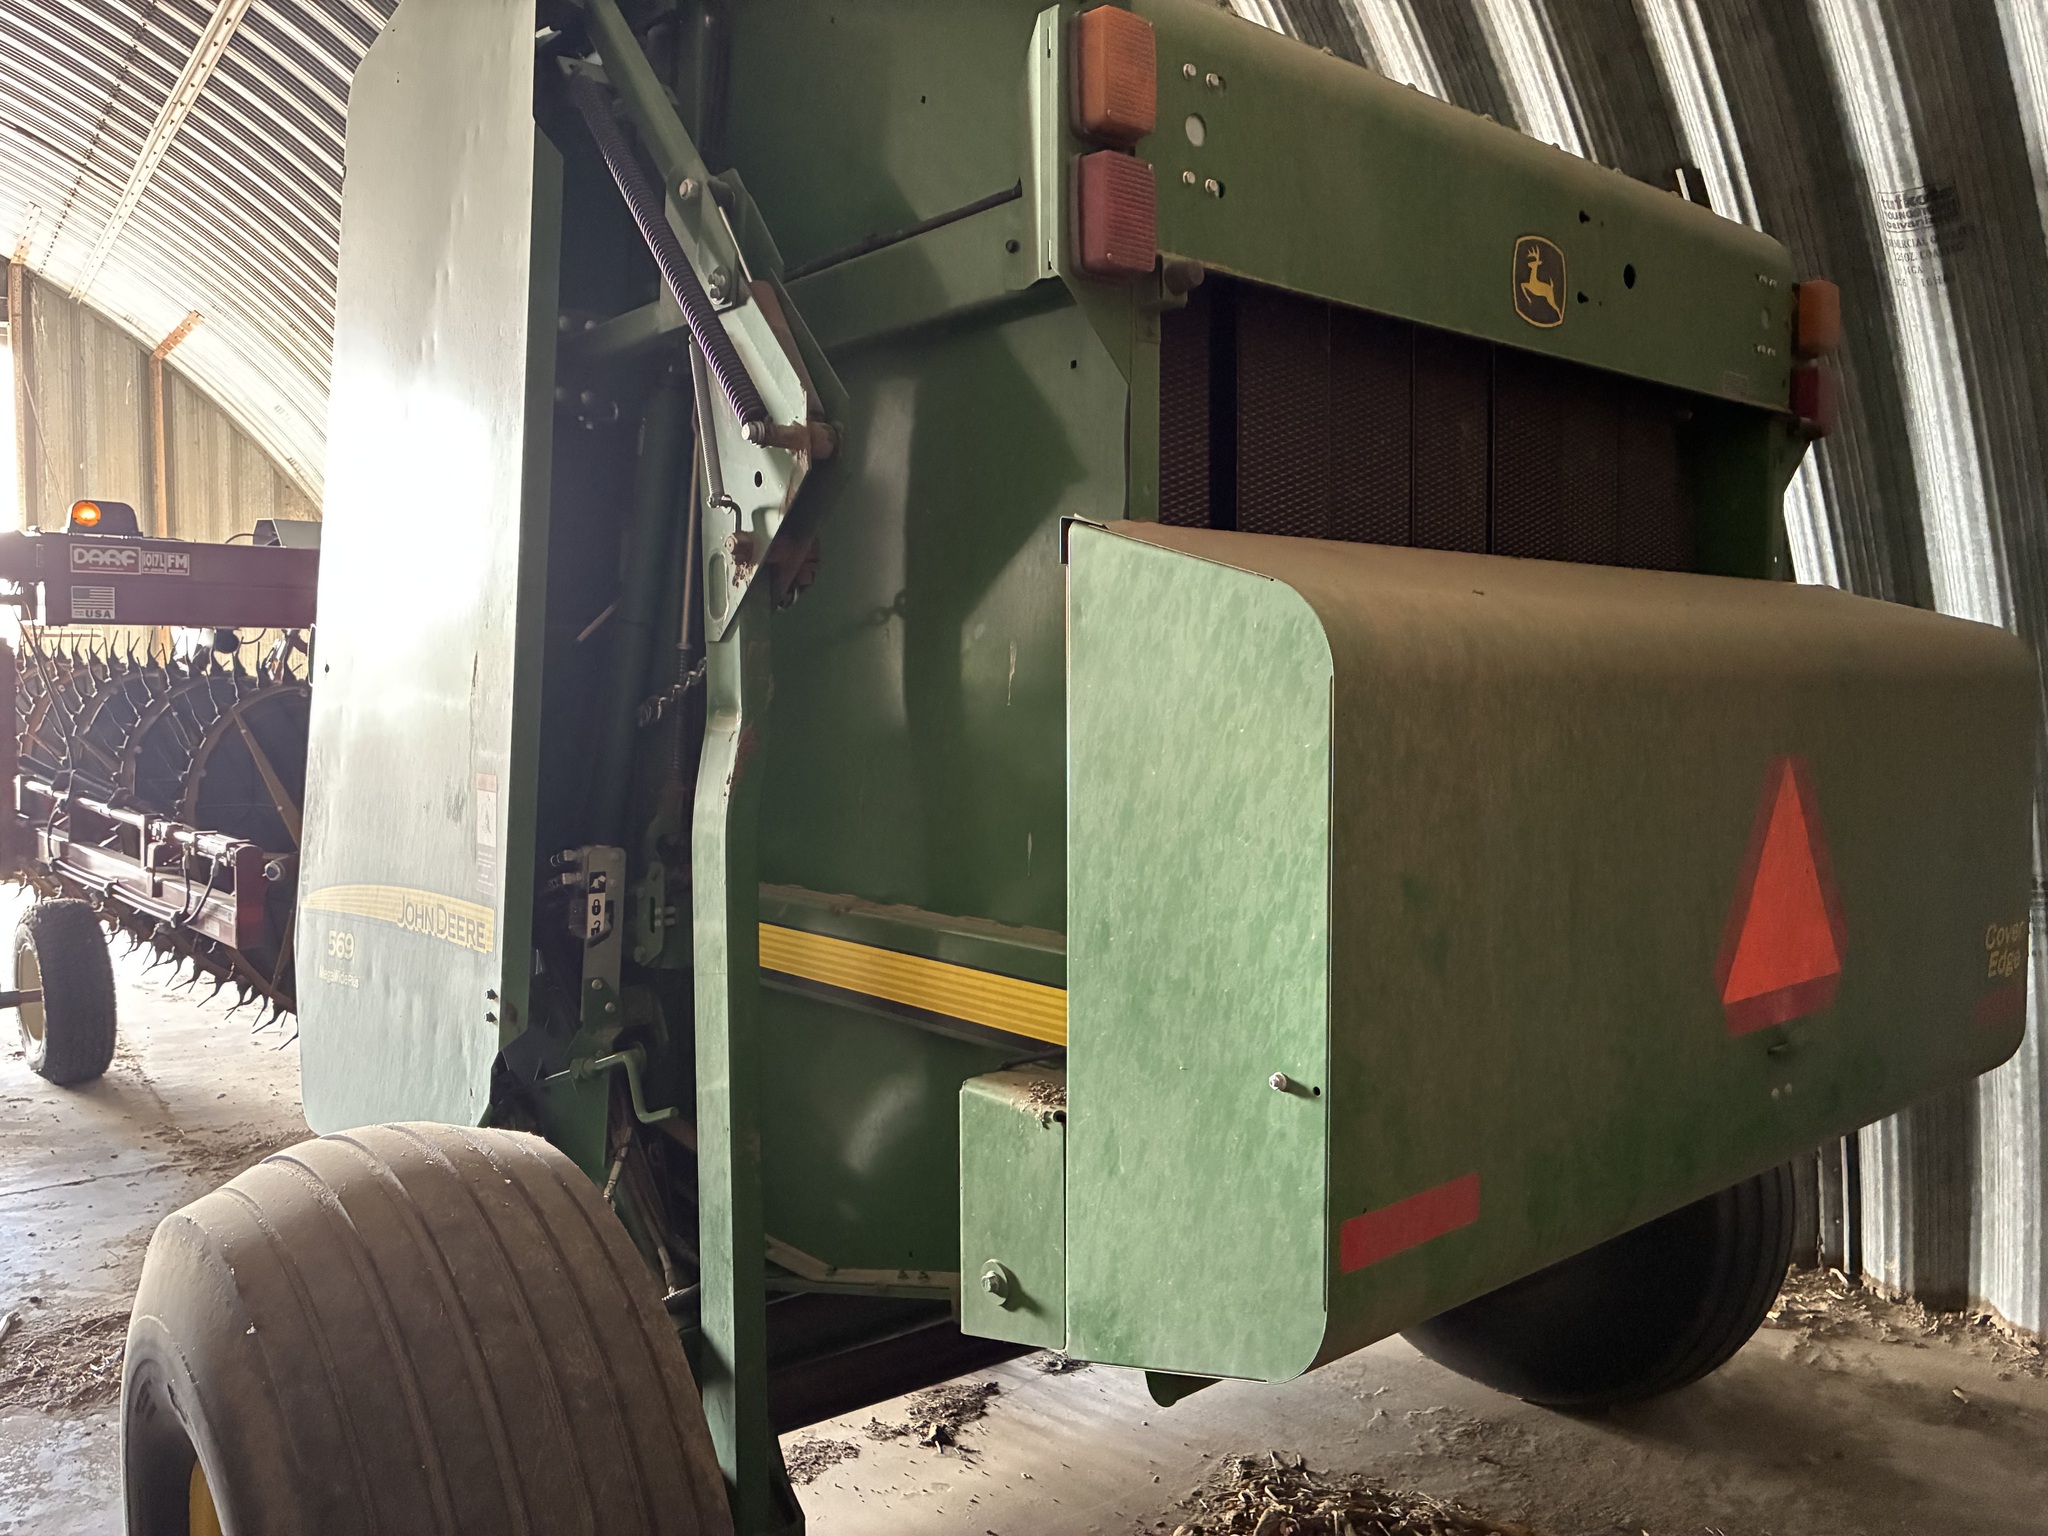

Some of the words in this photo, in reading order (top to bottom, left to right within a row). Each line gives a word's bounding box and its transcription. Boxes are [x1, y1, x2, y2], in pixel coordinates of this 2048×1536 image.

[73, 547, 137, 567] DARF
[167, 554, 188, 569] FM
[85, 609, 111, 618] USA
[397, 894, 434, 932] JOHN
[436, 903, 486, 950] DEERE
[1985, 921, 2025, 951] Cover
[327, 929, 356, 960] 569
[1988, 948, 2021, 978] Edge
